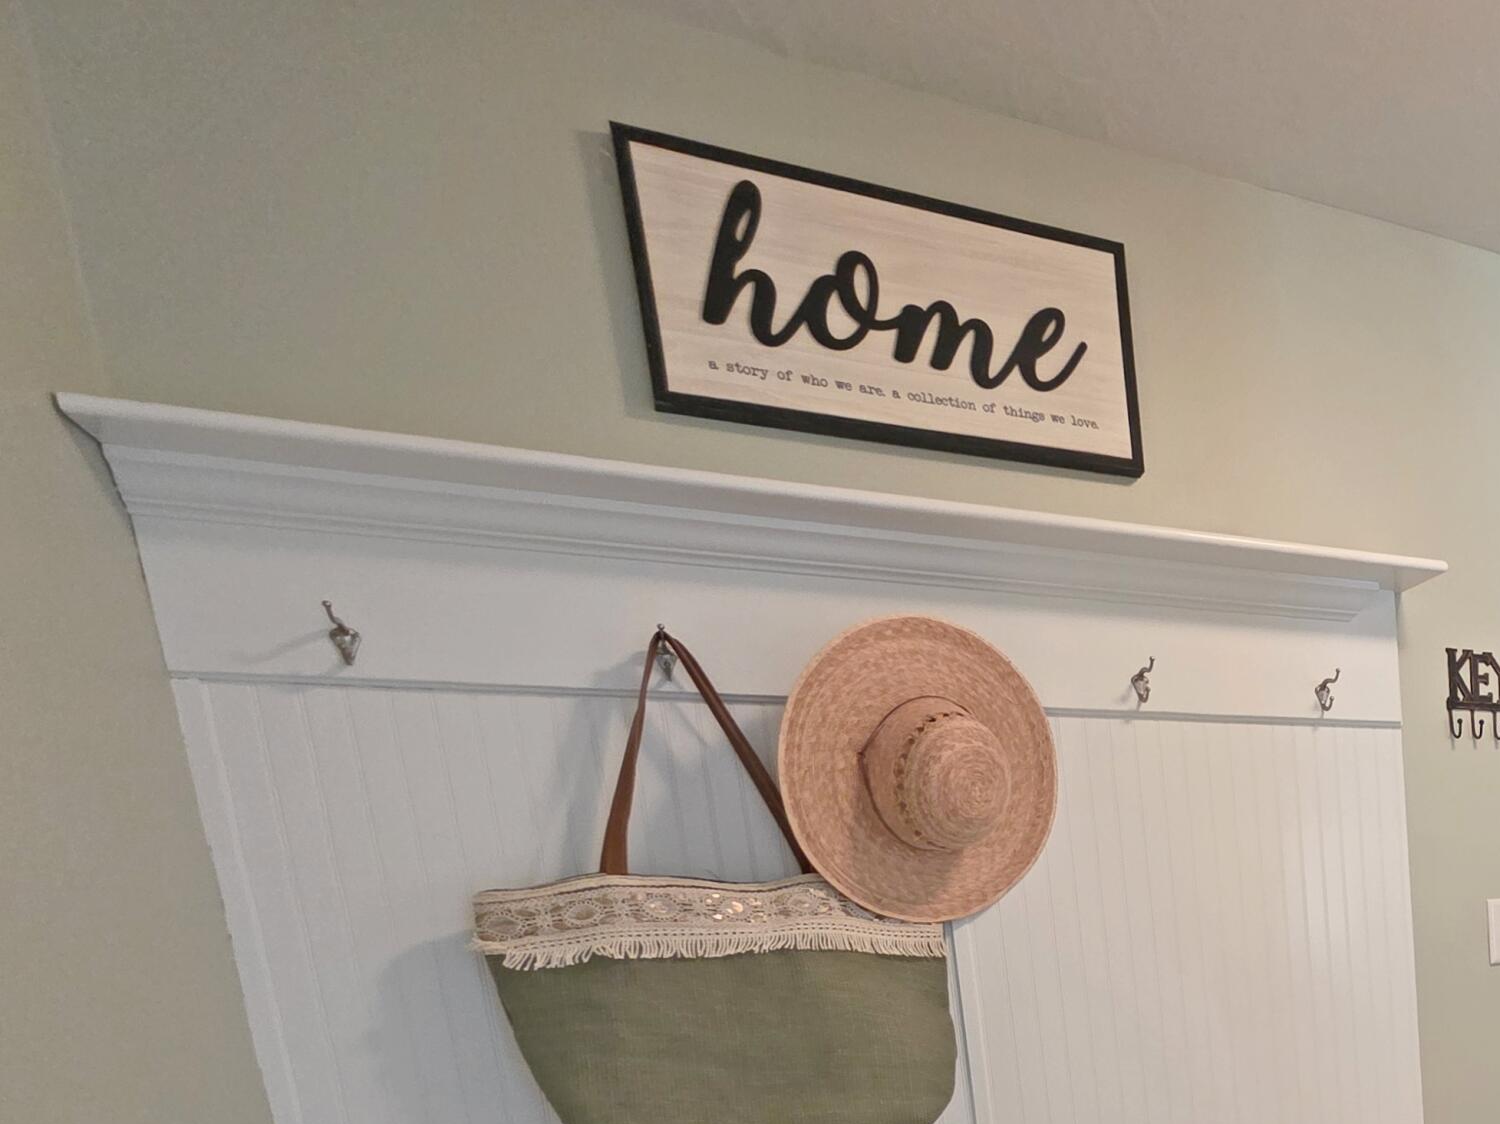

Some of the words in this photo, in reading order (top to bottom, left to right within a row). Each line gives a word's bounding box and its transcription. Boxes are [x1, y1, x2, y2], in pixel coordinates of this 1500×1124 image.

[703, 179, 1088, 392] home
[708, 360, 719, 370] a
[726, 361, 768, 380] story
[776, 370, 793, 382] of
[800, 374, 828, 388] who
[835, 380, 852, 391] we
[892, 390, 902, 399] a
[907, 391, 977, 411] collection
[982, 402, 996, 413] of
[1003, 405, 1045, 423] things
[1050, 413, 1065, 425] we
